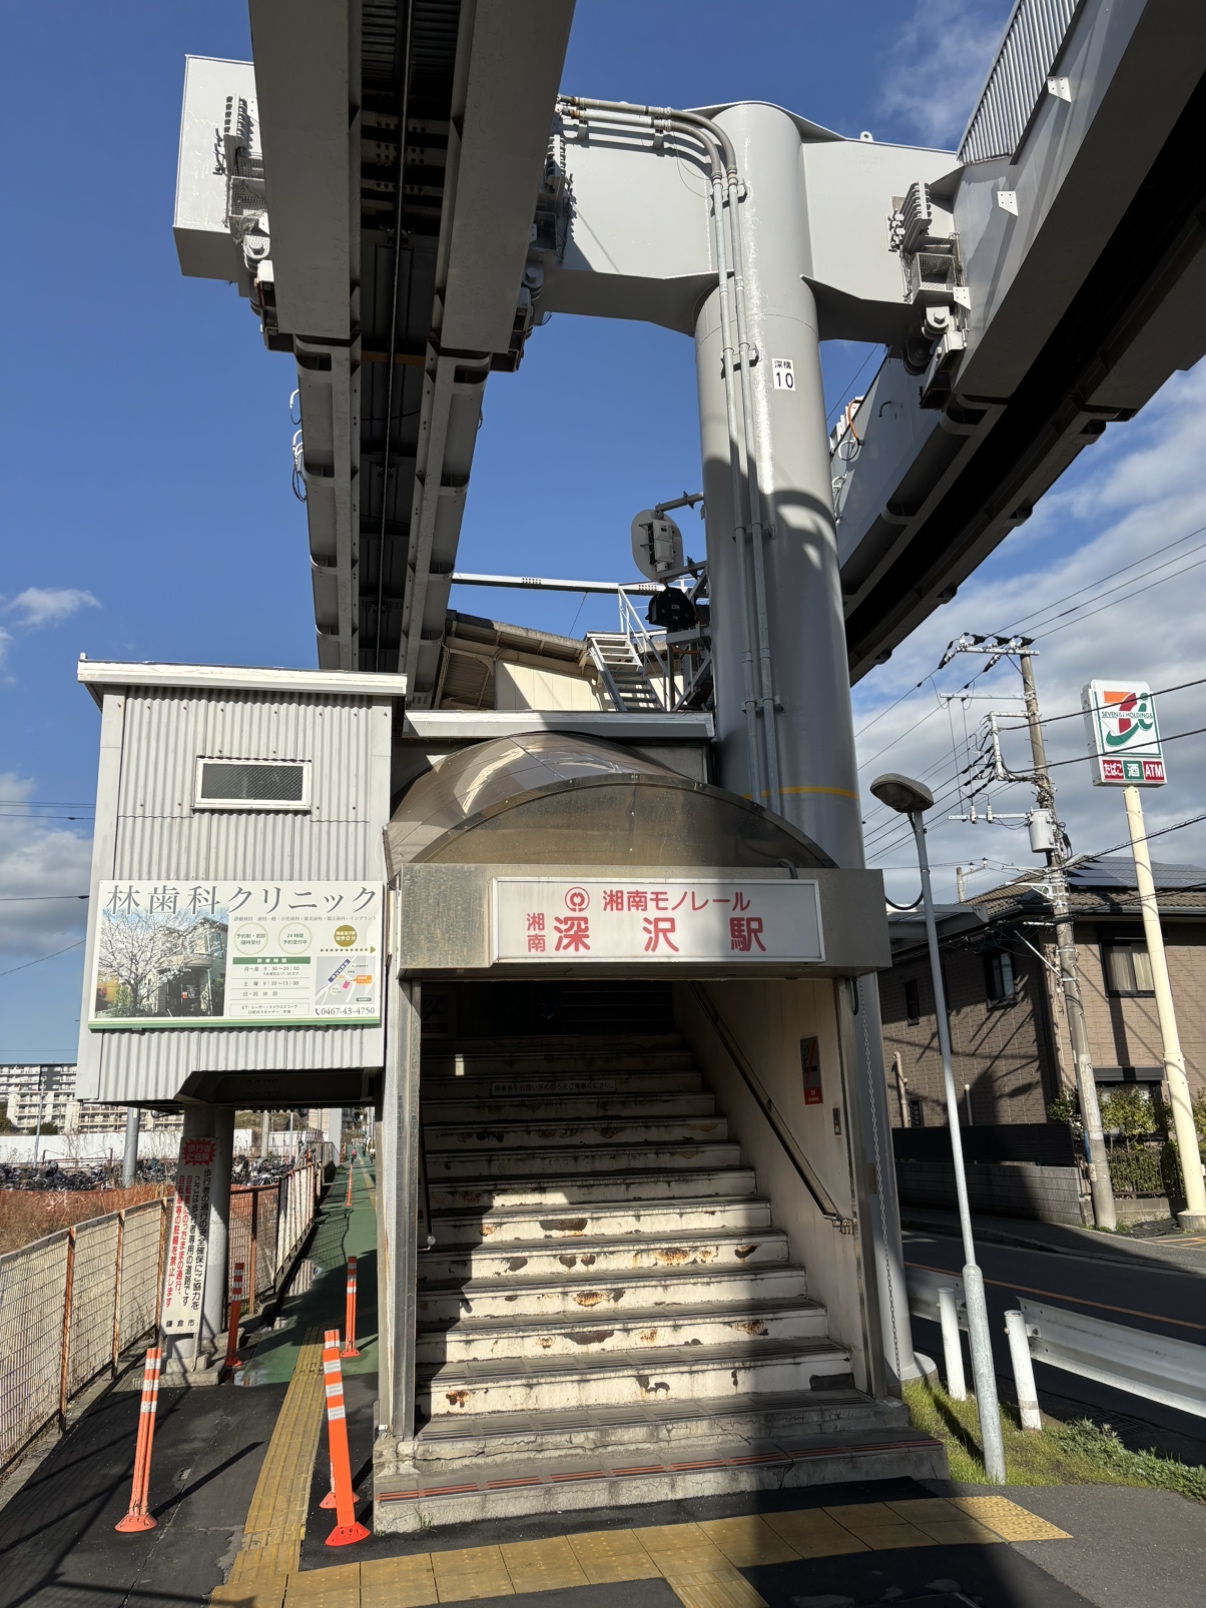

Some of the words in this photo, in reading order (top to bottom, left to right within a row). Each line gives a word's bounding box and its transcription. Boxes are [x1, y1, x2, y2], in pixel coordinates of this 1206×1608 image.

[776, 371, 794, 389] 10
[1103, 762, 1124, 777] たばこ
[1127, 763, 1140, 778] 酒
[1145, 764, 1164, 778] ATM
[106, 885, 377, 915] 林歯科クリニック
[602, 889, 751, 912] 湘南モノレール
[526, 912, 546, 953] 湘南
[320, 1006, 376, 1015] 0467-43-4750
[165, 1175, 185, 1308] 自転車等の駐輪を禁止します
[182, 1175, 200, 1307] ここは歩行者専用の道路です
[190, 1168, 212, 1311] 歩行者の通行の安全確保にご協力を
